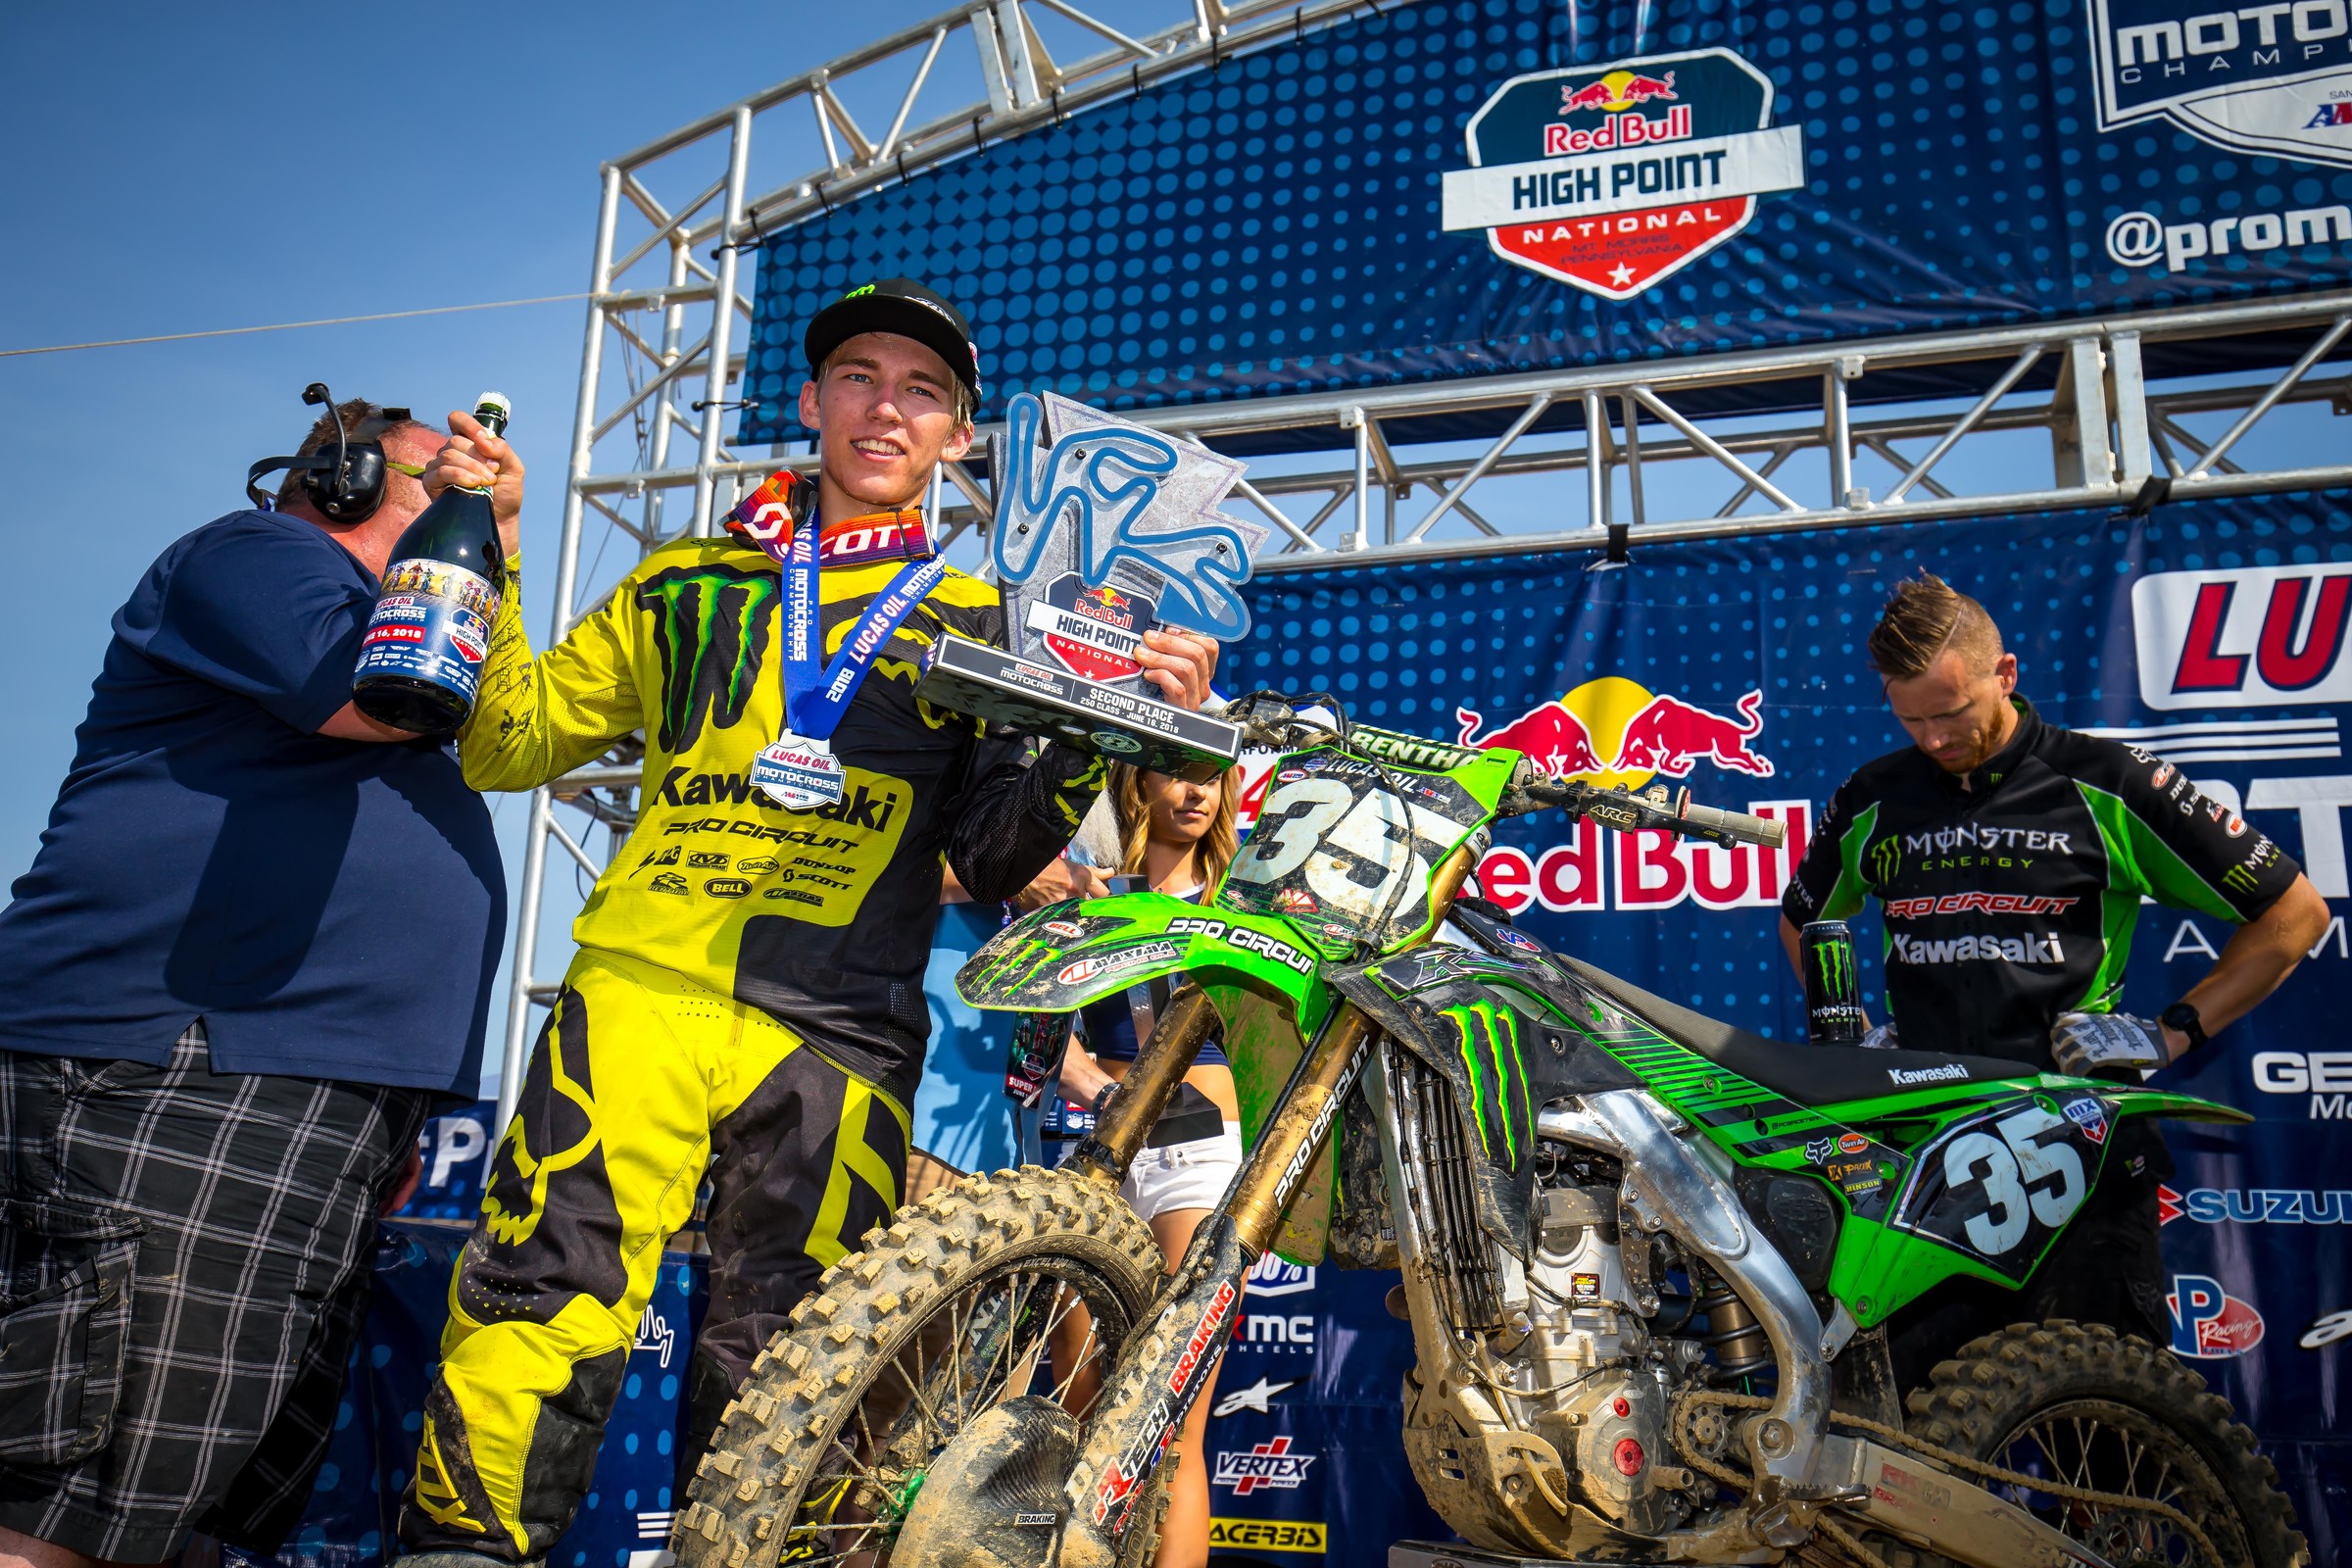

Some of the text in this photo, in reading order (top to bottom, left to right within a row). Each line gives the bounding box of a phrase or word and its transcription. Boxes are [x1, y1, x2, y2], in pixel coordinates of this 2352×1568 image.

[2117, 0, 2352, 67] MOTO
[1544, 104, 1692, 157] Red Bull
[1513, 150, 1728, 211] HIGH POINT
[1523, 208, 1722, 244] NATIONAL
[1560, 242, 1685, 266] PENNSYLVANIA
[1605, 233, 1671, 250] MORRIS
[794, 568, 808, 662] MOTOCROSS
[1074, 598, 1133, 629] Red Bull
[392, 628, 422, 639] 2018
[1056, 614, 1141, 654] HIGH POINT
[825, 667, 856, 704] 2018
[849, 613, 891, 665] LUCAS
[1056, 640, 1132, 669] NATIONAL
[1000, 669, 1064, 696] MOTOCROSS
[1016, 663, 1054, 681] LUCAS OIL
[1080, 697, 1096, 708] 250
[1096, 702, 1120, 715] CLASS
[1126, 711, 1145, 723] JUNE
[1159, 721, 1180, 734] 2018
[1089, 688, 1175, 724] SECOND PLACE
[771, 750, 831, 771] LUCAS OIL
[1325, 759, 1382, 778] LUCAS
[757, 765, 840, 791] MOTOCROSS
[1589, 805, 1637, 825] ARC
[662, 817, 859, 854] PRO CIRCUIT
[1229, 777, 1470, 920] 35
[1905, 822, 2074, 857] MONSTER
[792, 857, 857, 875] DUNLOP
[1457, 799, 1812, 916] ed Bull
[1922, 856, 2034, 871] ENERGY
[711, 883, 745, 894] BELL
[795, 873, 853, 890] SCOTT
[1936, 890, 2081, 916] CIRCUIT
[1048, 921, 1075, 935] BELL
[1228, 927, 1315, 973] CIRCUI
[1893, 931, 2066, 964] Kawasaki
[1008, 1076, 1034, 1093] SUPER
[1887, 1063, 1970, 1087] Kawasaki
[1273, 1034, 1370, 1207] PRO CIRCUIT
[1841, 1140, 1857, 1149] Twin
[1845, 1179, 1881, 1193] HINSON
[1943, 1106, 2087, 1255] 35
[2185, 1189, 2352, 1224] SUZU
[1167, 1279, 1237, 1398] BRAKING
[2201, 1320, 2256, 1347] Racing
[1218, 1452, 1311, 1479] VERTEX
[1016, 1513, 1056, 1525] BRAKING
[1210, 1523, 1322, 1548] ACERBIS
